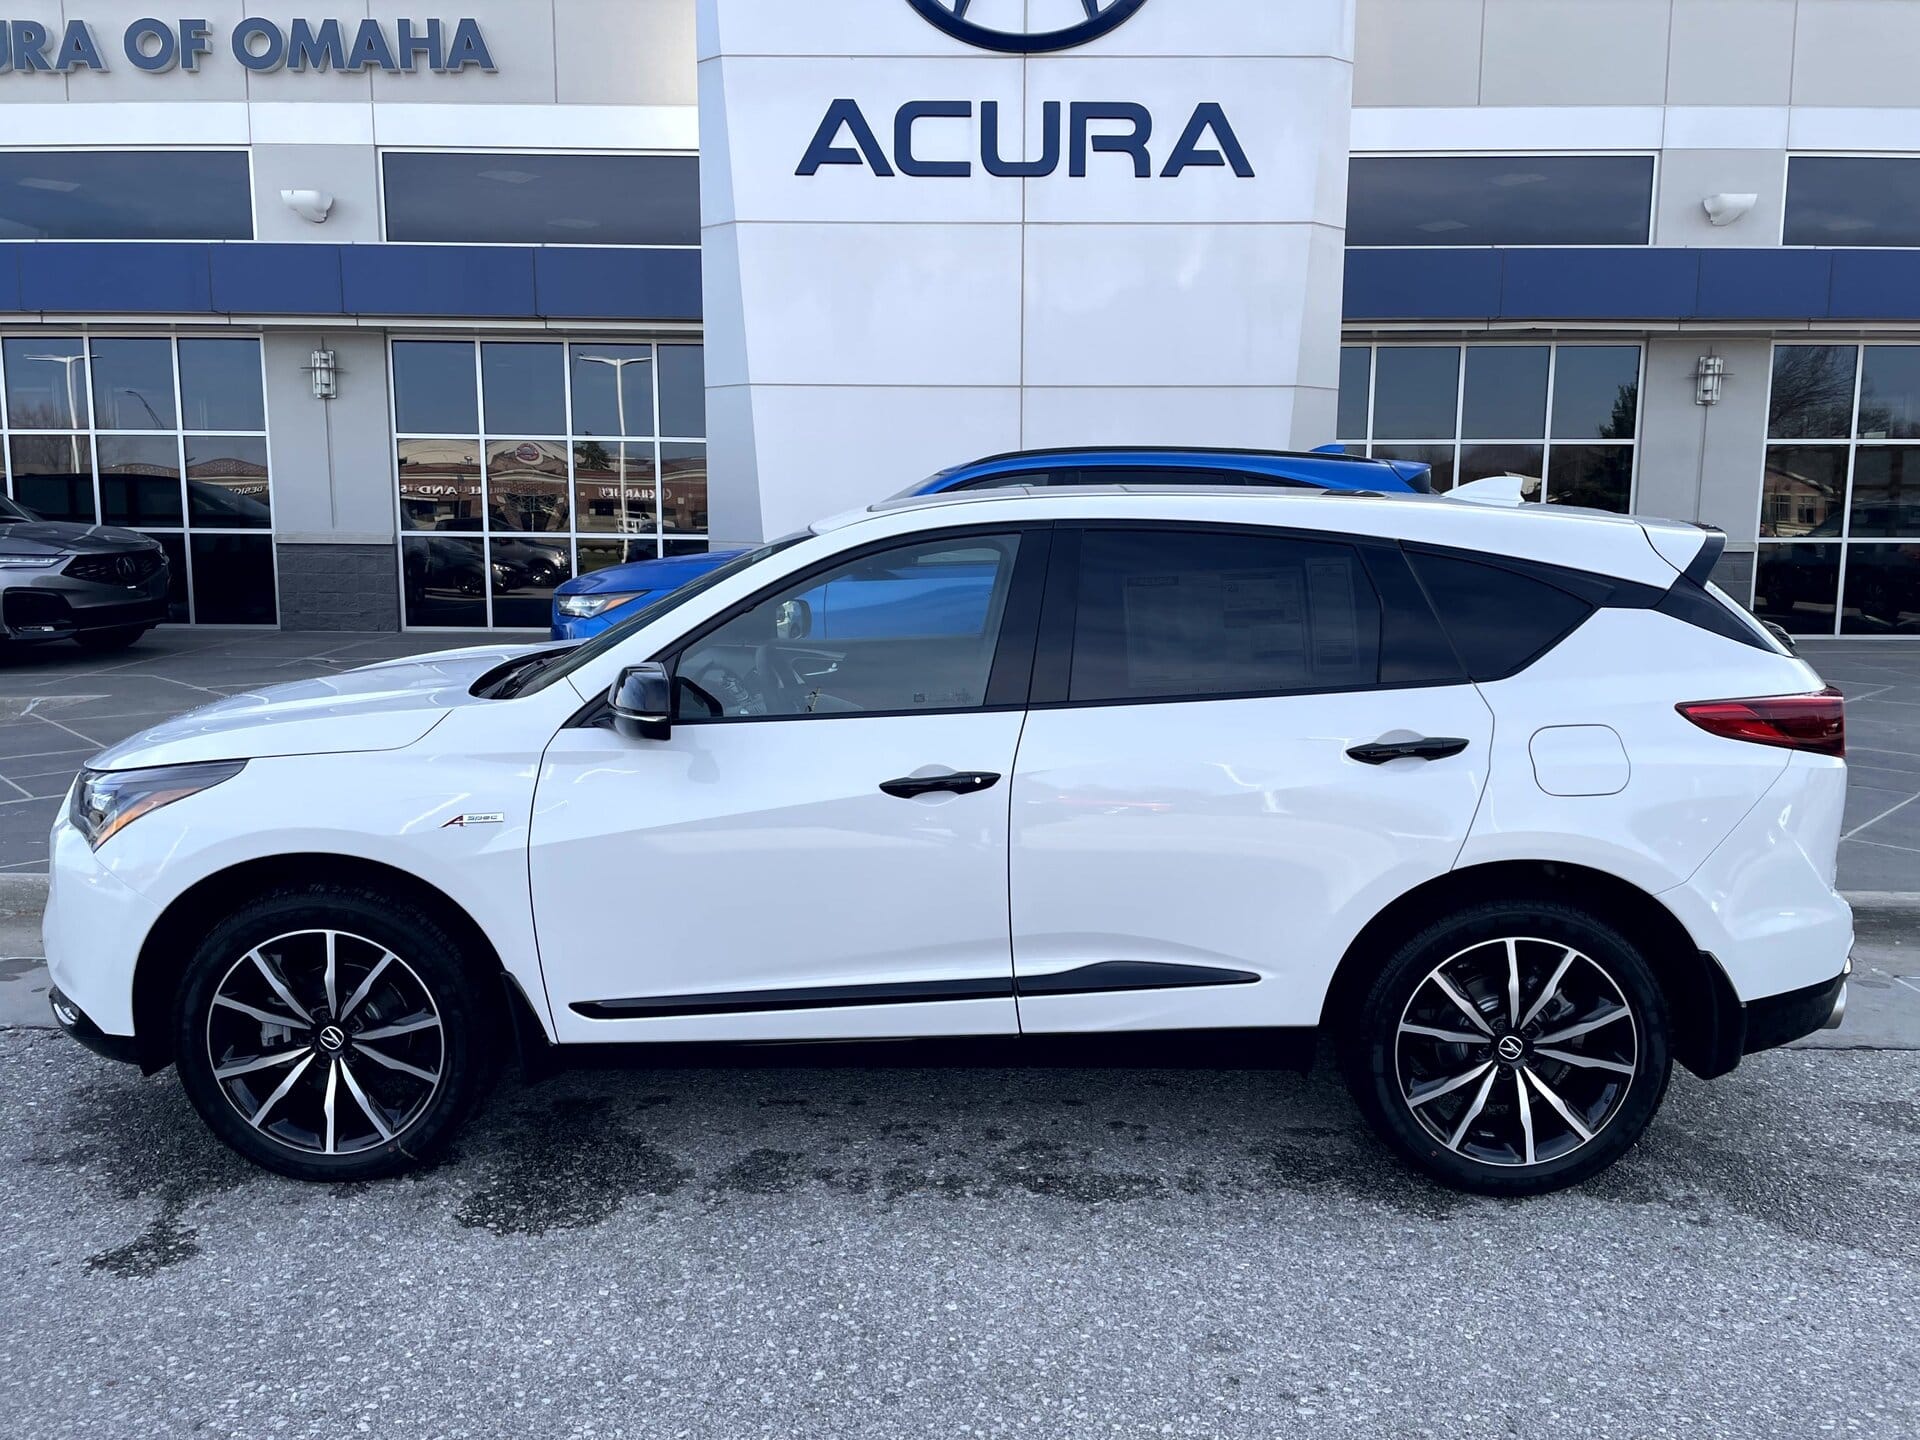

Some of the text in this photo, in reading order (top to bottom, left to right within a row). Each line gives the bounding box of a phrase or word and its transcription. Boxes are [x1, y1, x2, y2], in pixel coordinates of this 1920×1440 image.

[123, 17, 212, 73] OF
[231, 16, 498, 73] OMAHA
[794, 98, 1256, 178] ACURA
